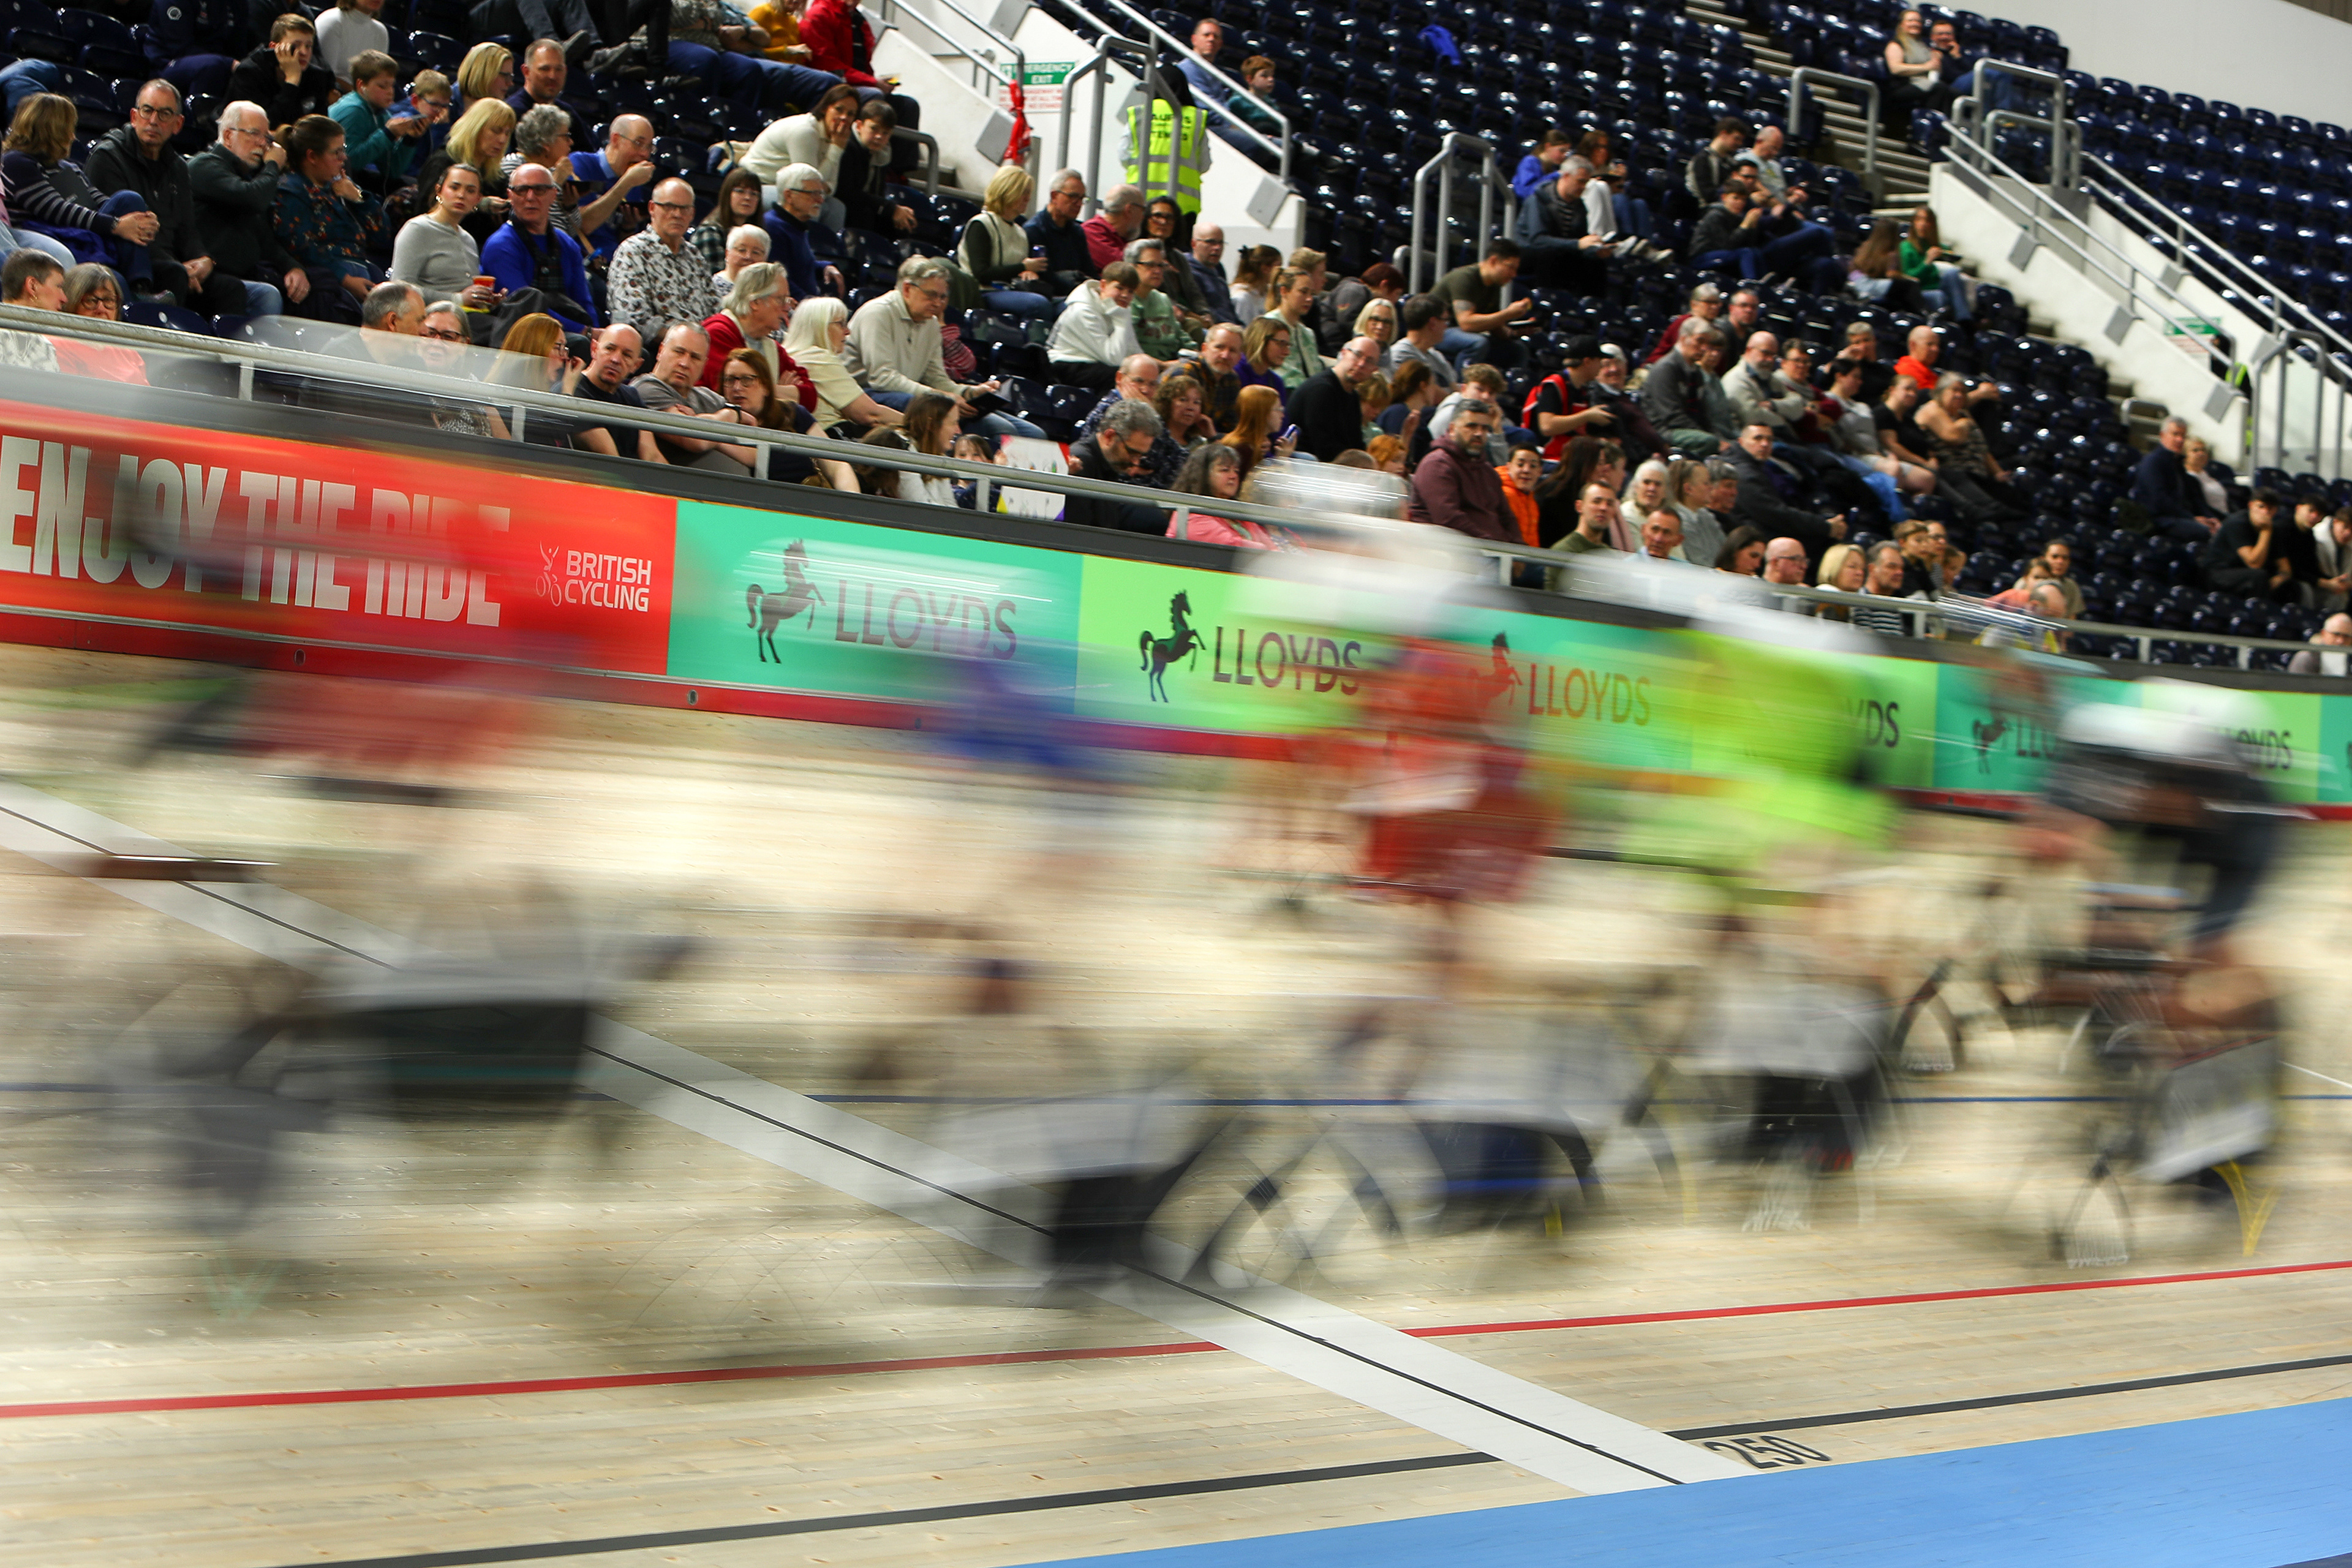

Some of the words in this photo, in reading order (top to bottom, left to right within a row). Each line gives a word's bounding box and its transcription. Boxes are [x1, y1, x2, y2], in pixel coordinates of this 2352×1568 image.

[1014, 64, 1072, 74] ERGENCY
[0, 435, 228, 592] ENJOY
[239, 470, 356, 611] THE
[365, 488, 510, 627] RIDE
[567, 549, 652, 585] BRITISH
[565, 579, 650, 612] CYCLING
[835, 579, 1017, 660] LLOYDS
[1213, 626, 1361, 695] LLOYDS
[1528, 663, 1651, 725] LLOYDS
[1703, 1435, 1832, 1469] 250
